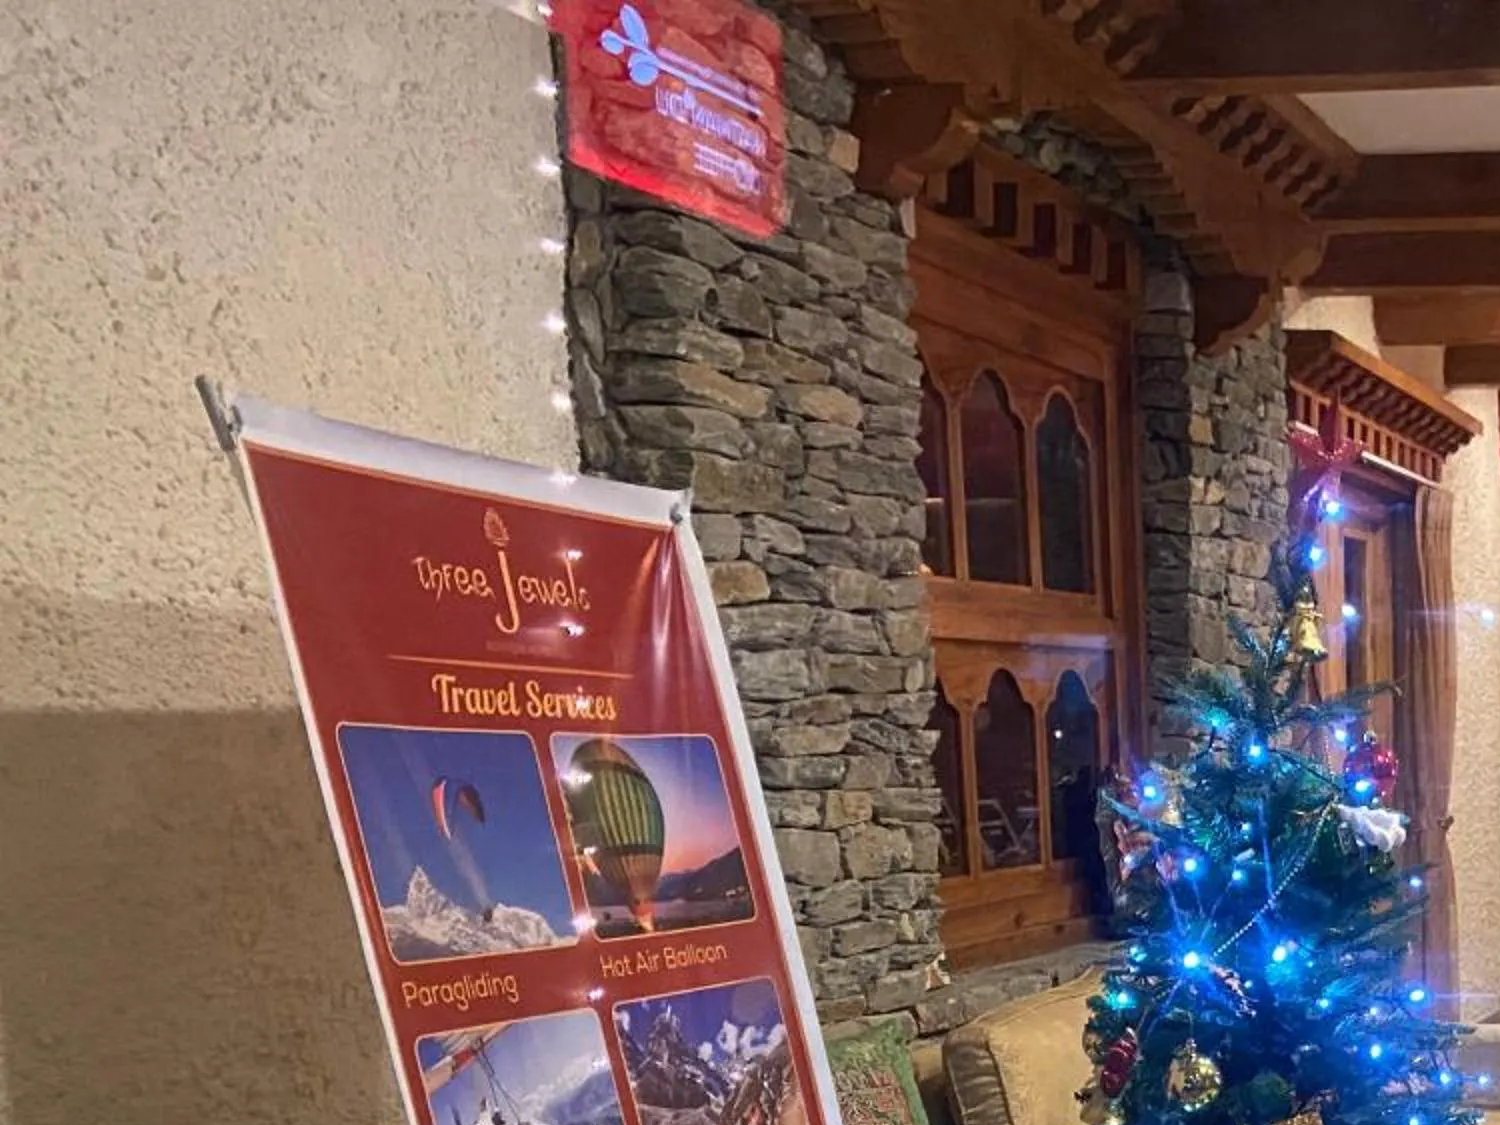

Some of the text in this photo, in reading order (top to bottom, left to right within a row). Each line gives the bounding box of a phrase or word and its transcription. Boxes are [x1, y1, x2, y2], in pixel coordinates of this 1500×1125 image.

[412, 549, 592, 634] Three Jewels
[431, 672, 618, 722] Travel Services
[600, 943, 728, 979] Hot Air Balloon
[402, 973, 520, 1012] Paragliding
